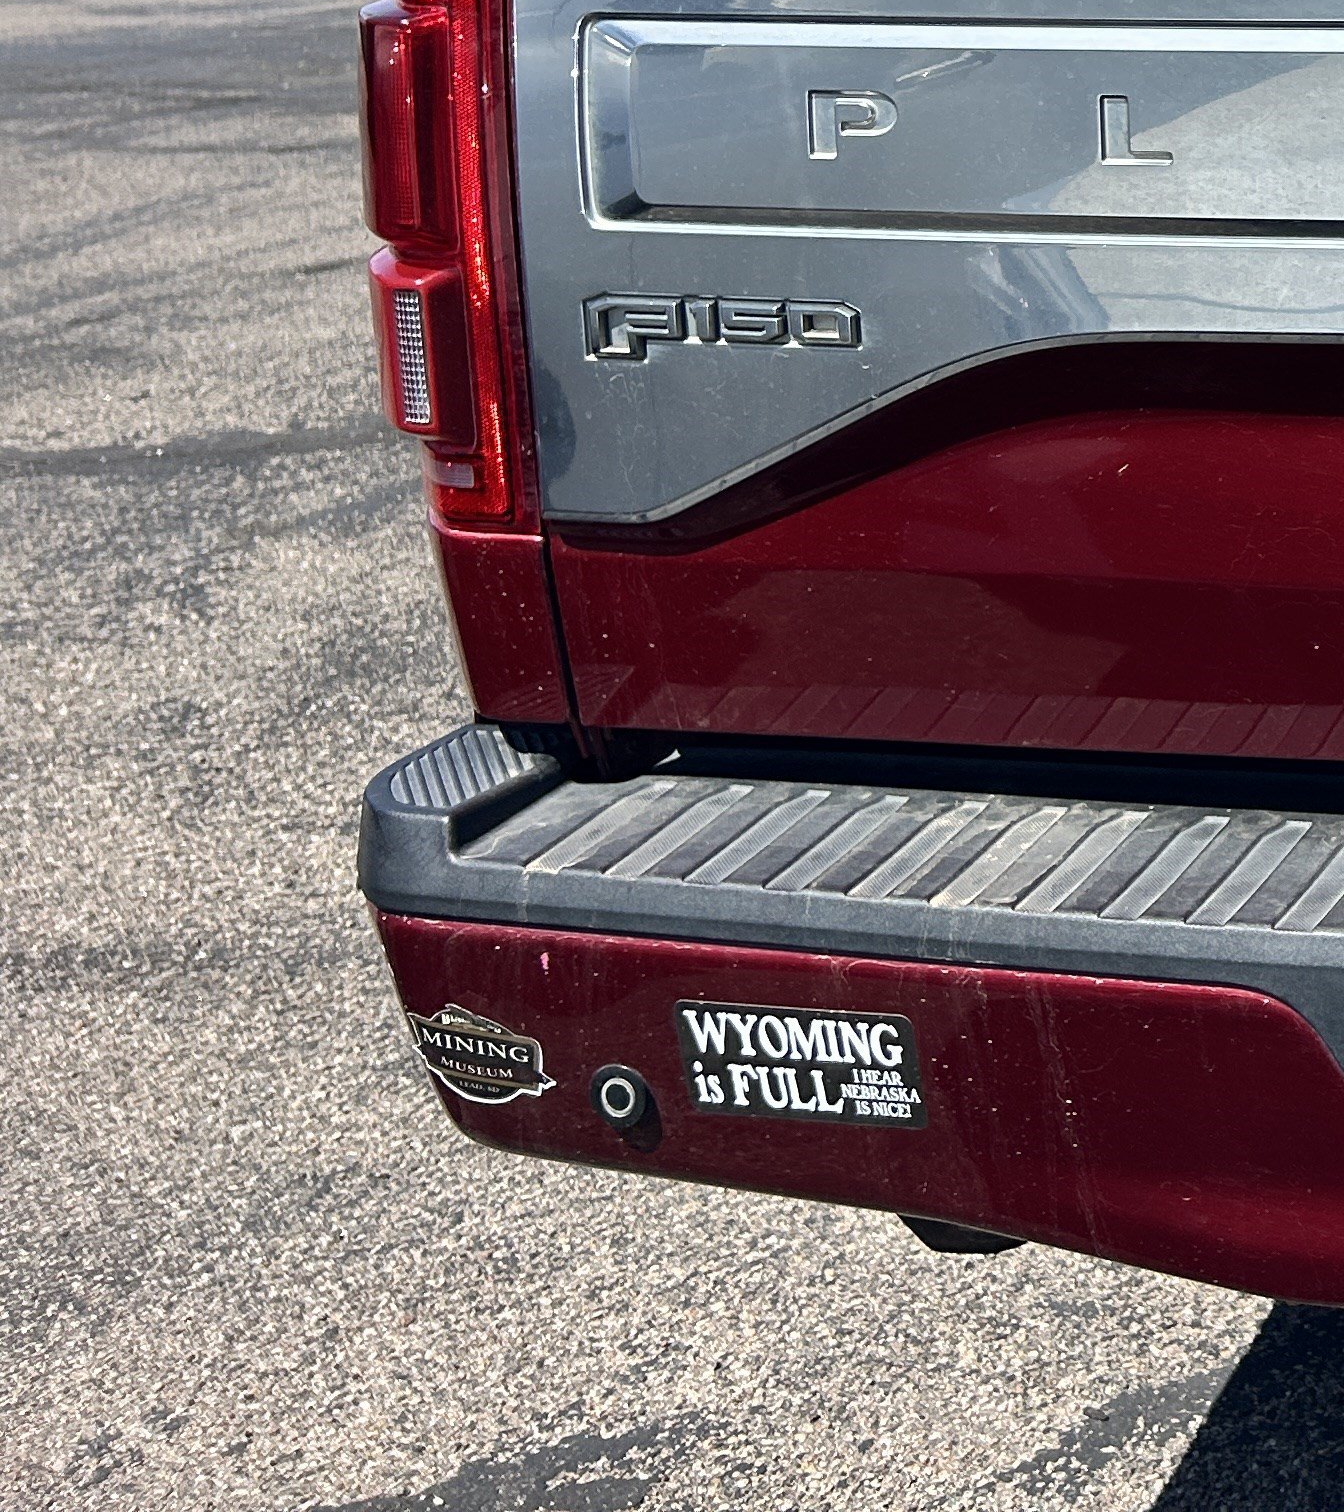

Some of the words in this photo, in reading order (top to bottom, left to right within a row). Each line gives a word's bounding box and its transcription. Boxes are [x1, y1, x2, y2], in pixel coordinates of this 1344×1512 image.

[421, 1027, 530, 1063] MINING
[682, 1009, 904, 1067] WYOMING
[440, 1055, 514, 1079] MUSEUM
[852, 1068, 862, 1083] I
[863, 1069, 904, 1087] HEAR
[692, 1060, 726, 1105] is
[727, 1063, 845, 1115] FULL
[839, 1083, 922, 1104] NEBRASKA
[856, 1101, 872, 1116] IS
[873, 1101, 913, 1119] NICE!
